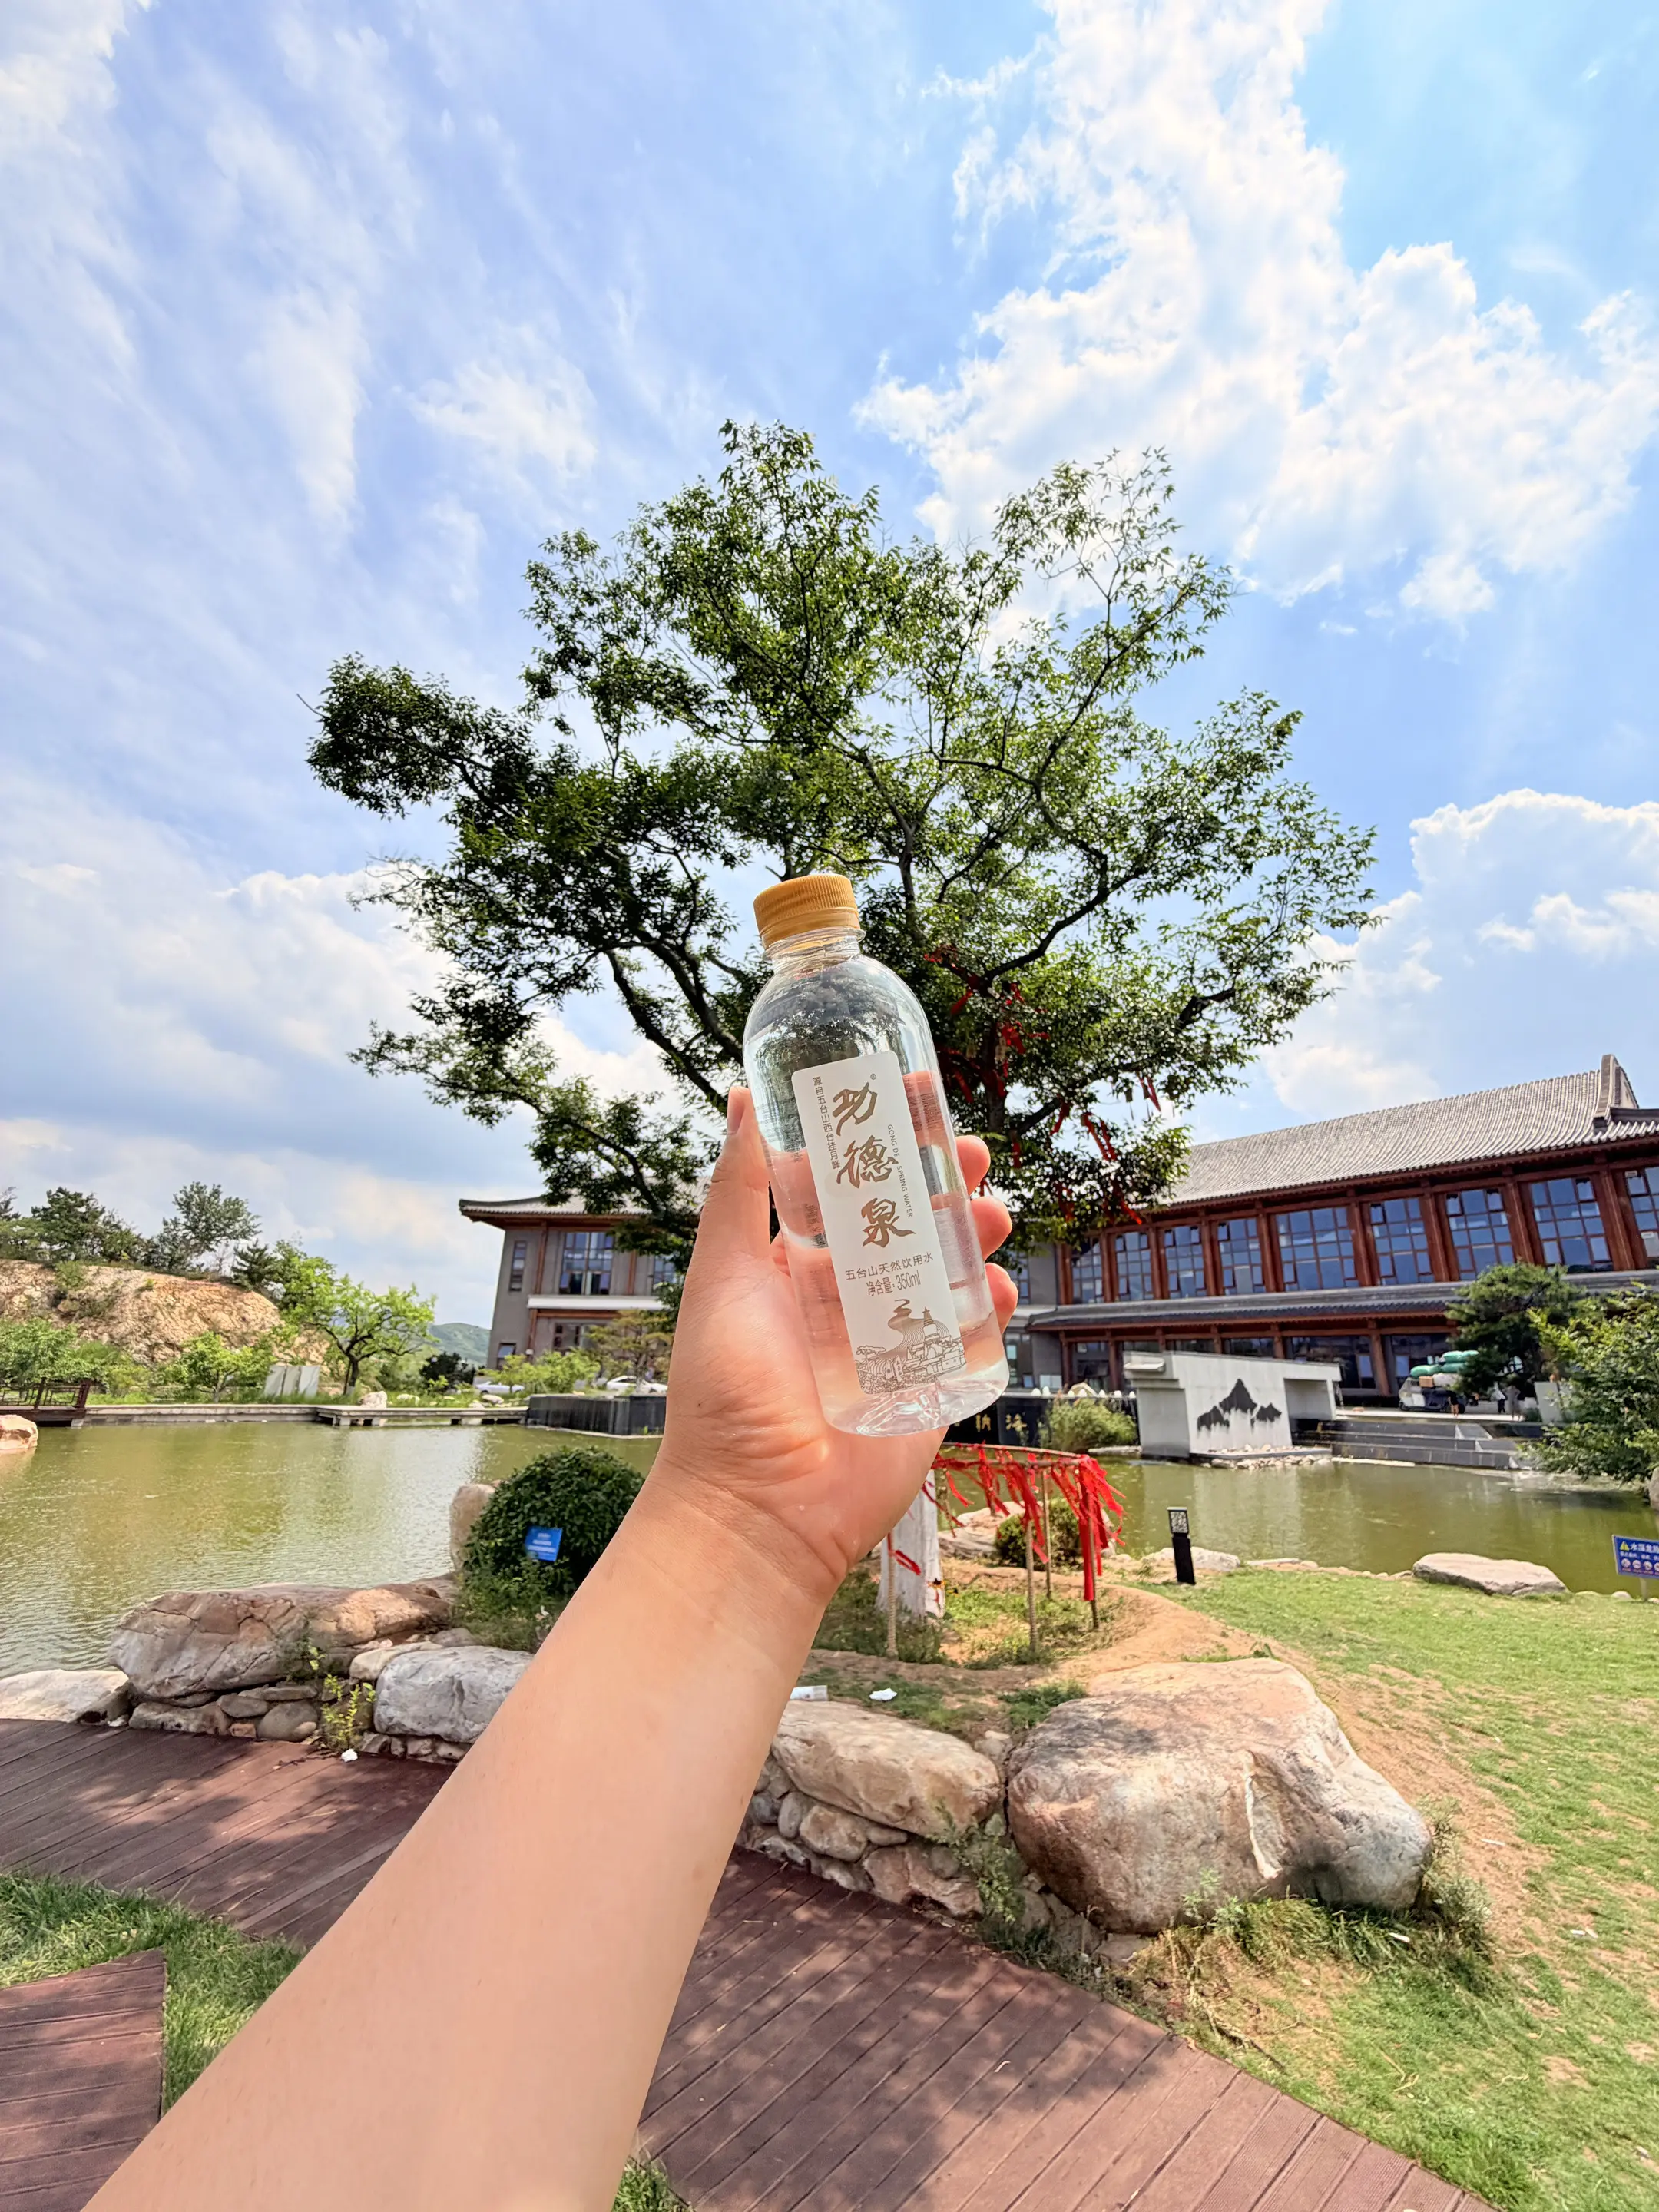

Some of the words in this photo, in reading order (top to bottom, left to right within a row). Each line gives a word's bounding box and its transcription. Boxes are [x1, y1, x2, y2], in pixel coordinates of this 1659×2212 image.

[812, 1076, 841, 1170] 源自五台山西台挂月峰
[887, 1124, 898, 1147] GONG
[832, 1081, 916, 1248] 功德泉
[892, 1147, 900, 1157] DE
[896, 1165, 907, 1192] SPRING
[902, 1193, 913, 1218] WATER
[845, 1252, 934, 1280] 五台山天然饮用水
